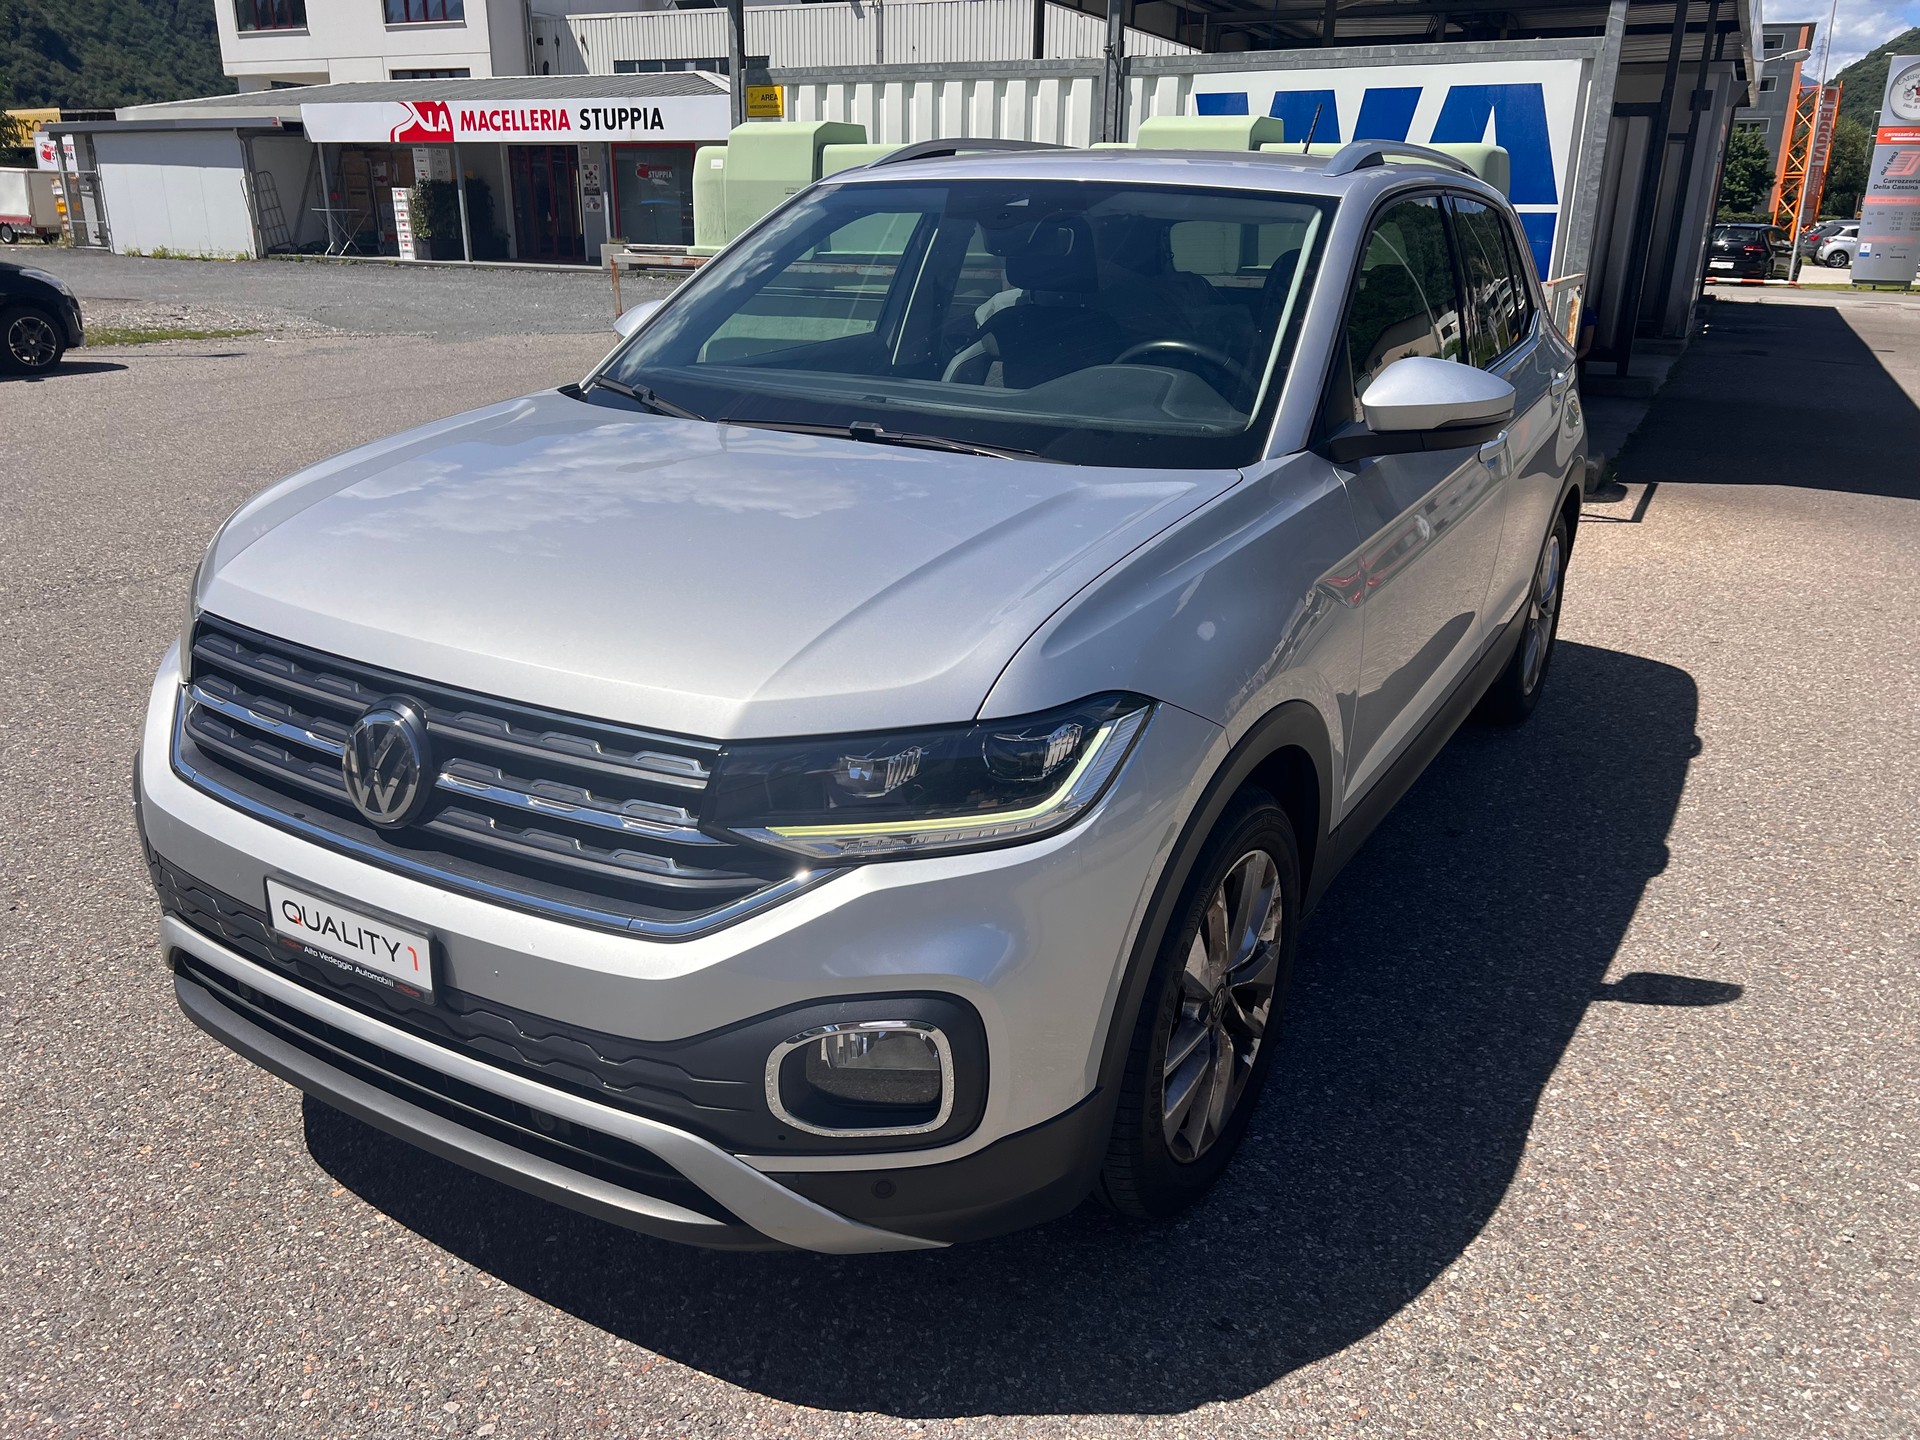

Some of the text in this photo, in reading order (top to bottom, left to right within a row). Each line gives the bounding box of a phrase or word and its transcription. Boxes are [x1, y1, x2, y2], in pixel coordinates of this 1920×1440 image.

[761, 93, 779, 101] AREA
[460, 109, 572, 132] MACELLERIA
[579, 108, 665, 131] STUPPIA
[1812, 107, 1834, 163] TADDEI
[648, 170, 673, 179] STUPPIA
[281, 900, 419, 972] QUALITY 1
[304, 946, 394, 988] Alto Vedeggio Automobili
